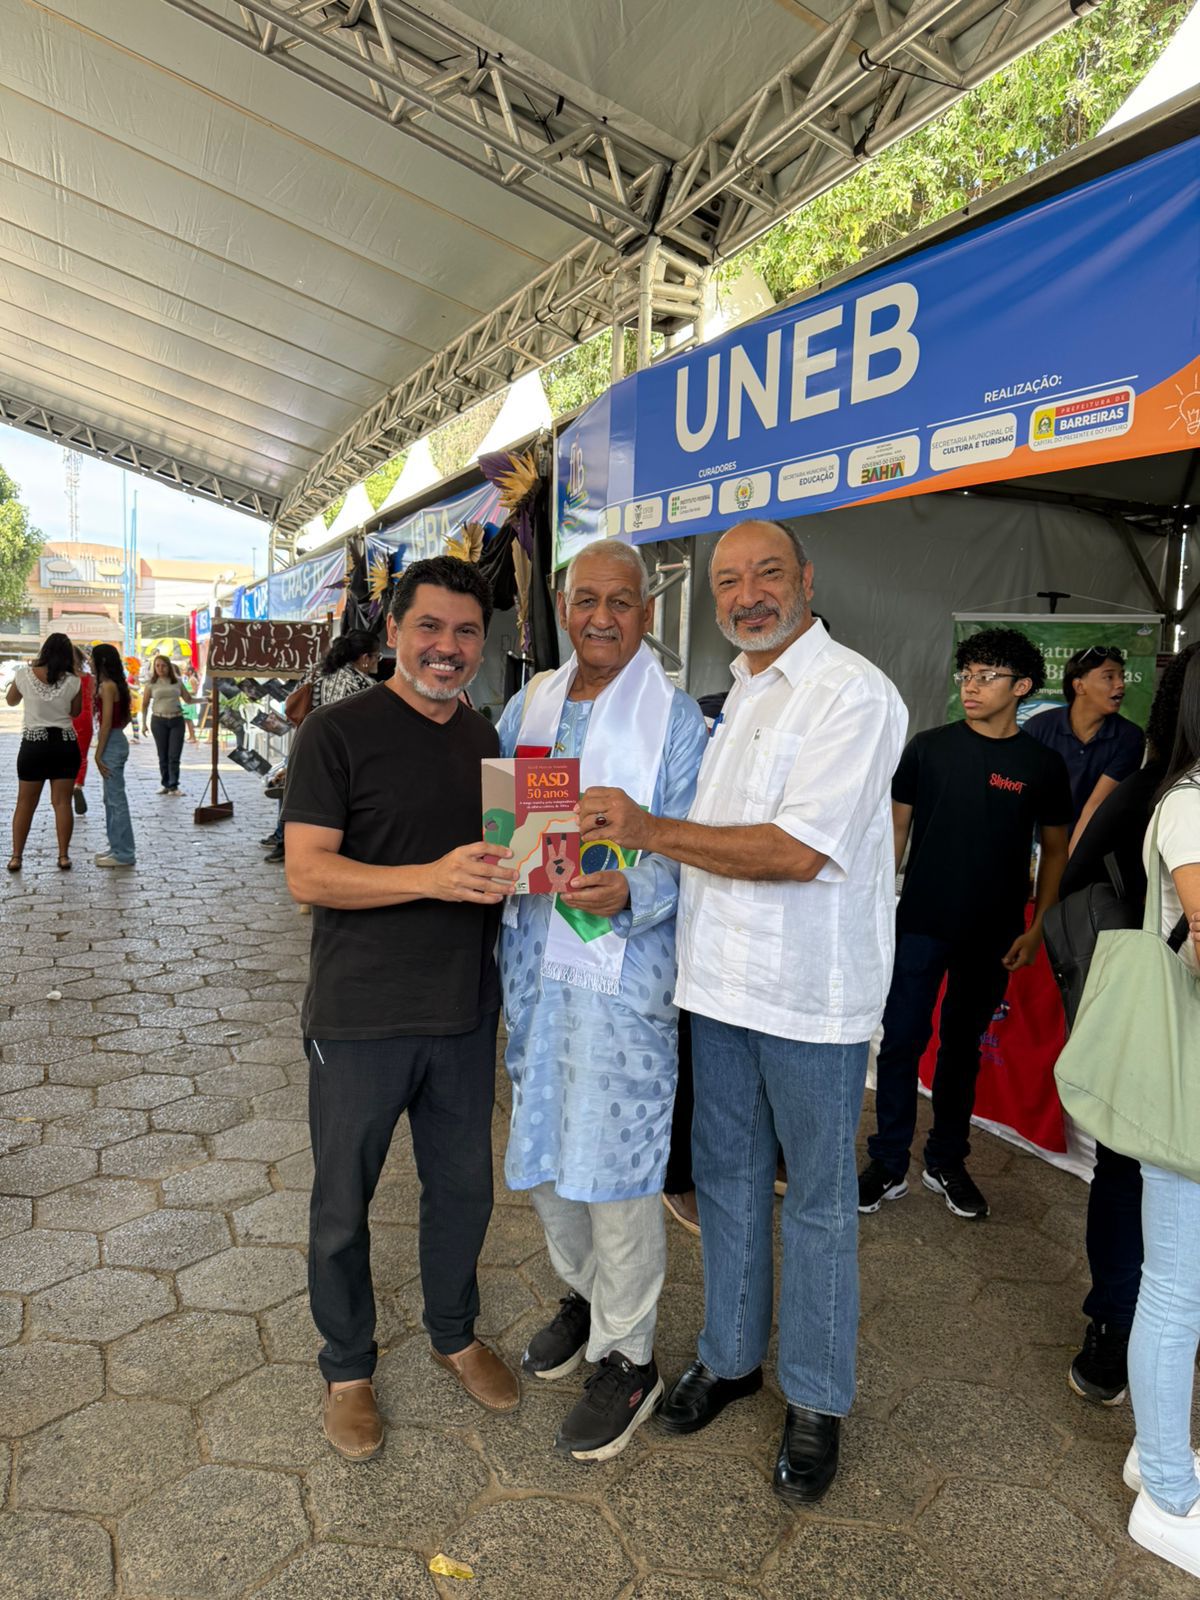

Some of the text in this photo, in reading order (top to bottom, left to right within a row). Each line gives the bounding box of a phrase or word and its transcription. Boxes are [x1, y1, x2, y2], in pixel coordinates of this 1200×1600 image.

[676, 282, 920, 452] UNEB
[984, 374, 1063, 403] REALIZAÇÃO:
[1060, 394, 1126, 414] PREFEITURA DE
[1059, 407, 1124, 431] BARREIRAS
[932, 426, 1014, 450] SECRETARIA MUNICIPAL DE
[942, 444, 974, 456] CULTURA
[981, 434, 1014, 447] TURISMO
[1033, 438, 1054, 447] CAPITAL
[1063, 432, 1089, 442] PRESENTE
[1106, 424, 1128, 434] FUTURO
[698, 461, 737, 478] CURADORES
[799, 471, 835, 486] EDUCAÇÃO
[527, 772, 570, 787] RASD
[527, 788, 569, 799] 50 anos
